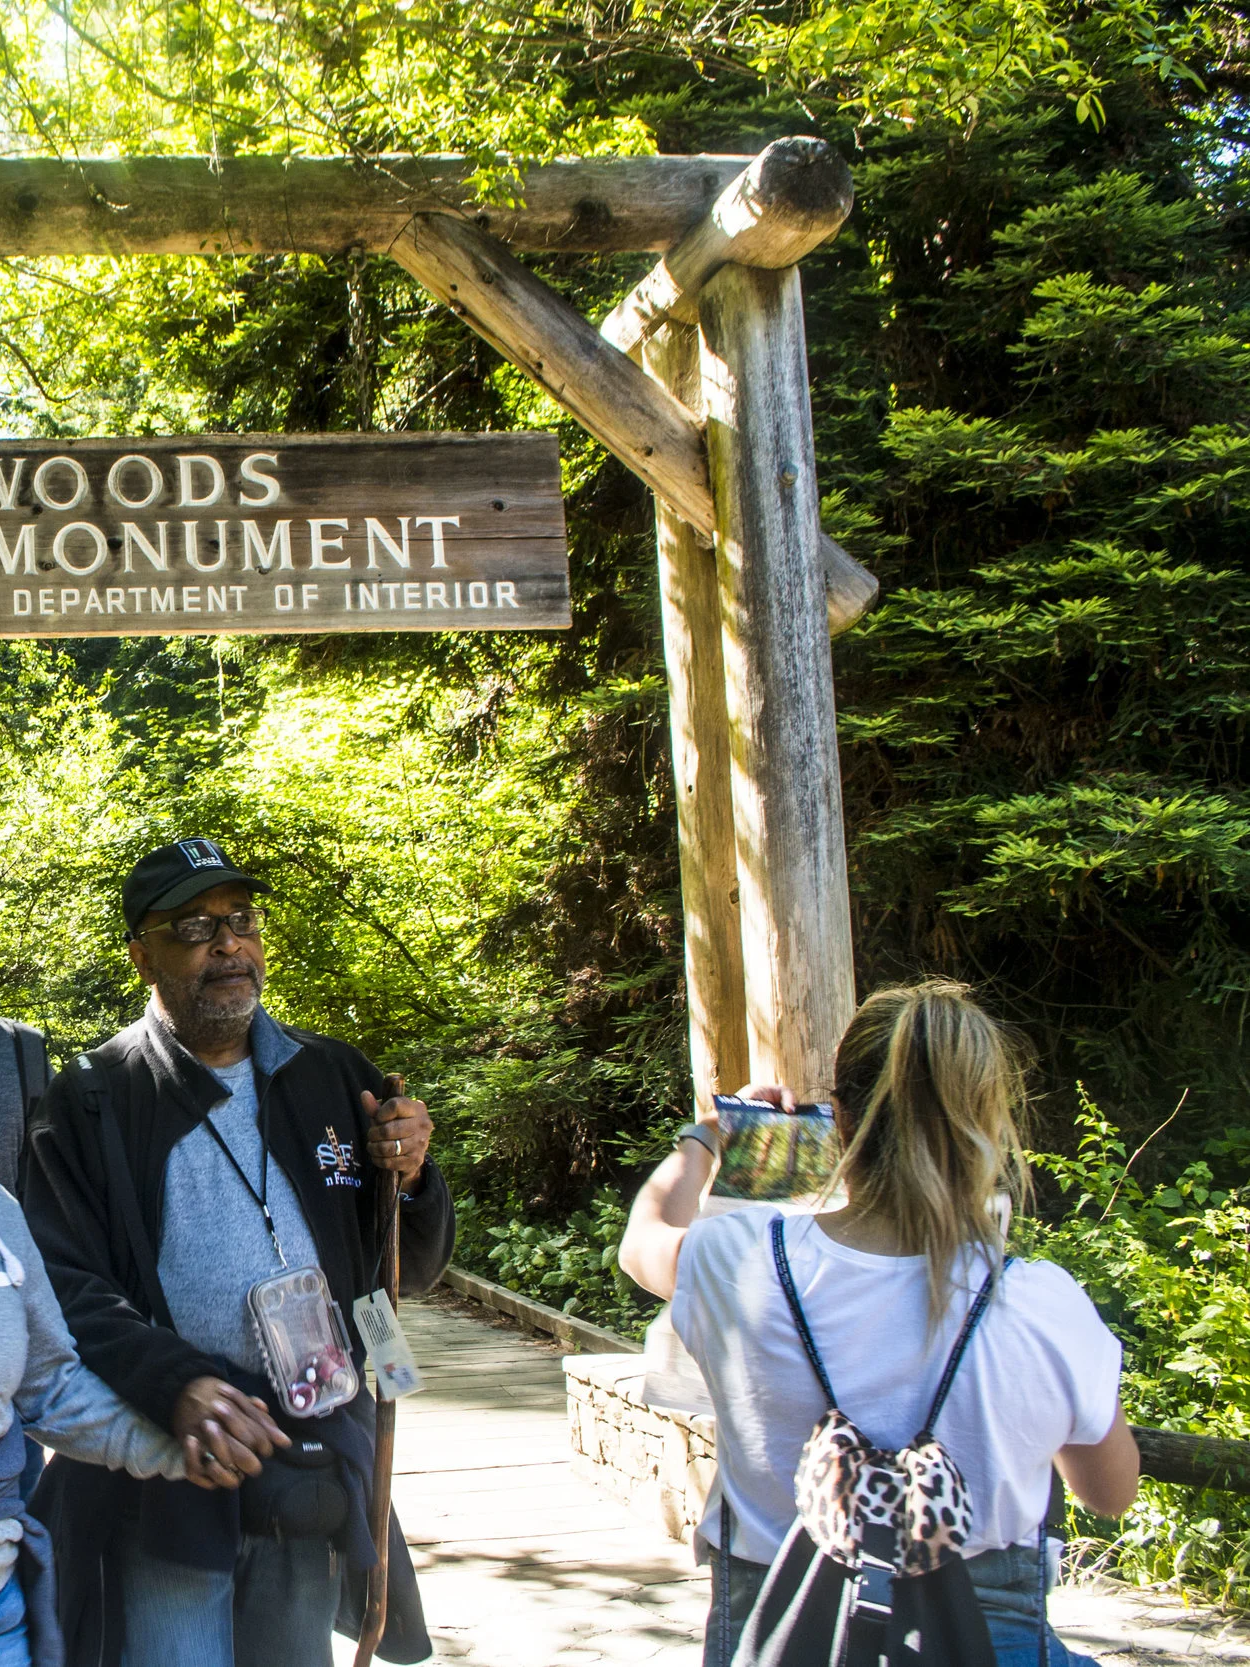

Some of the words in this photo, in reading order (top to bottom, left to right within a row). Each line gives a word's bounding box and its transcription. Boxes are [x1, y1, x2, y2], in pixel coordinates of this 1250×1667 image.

[13, 585, 248, 616] DEPARTMENT
[275, 583, 320, 612] OF
[344, 581, 520, 610] INTERIOR
